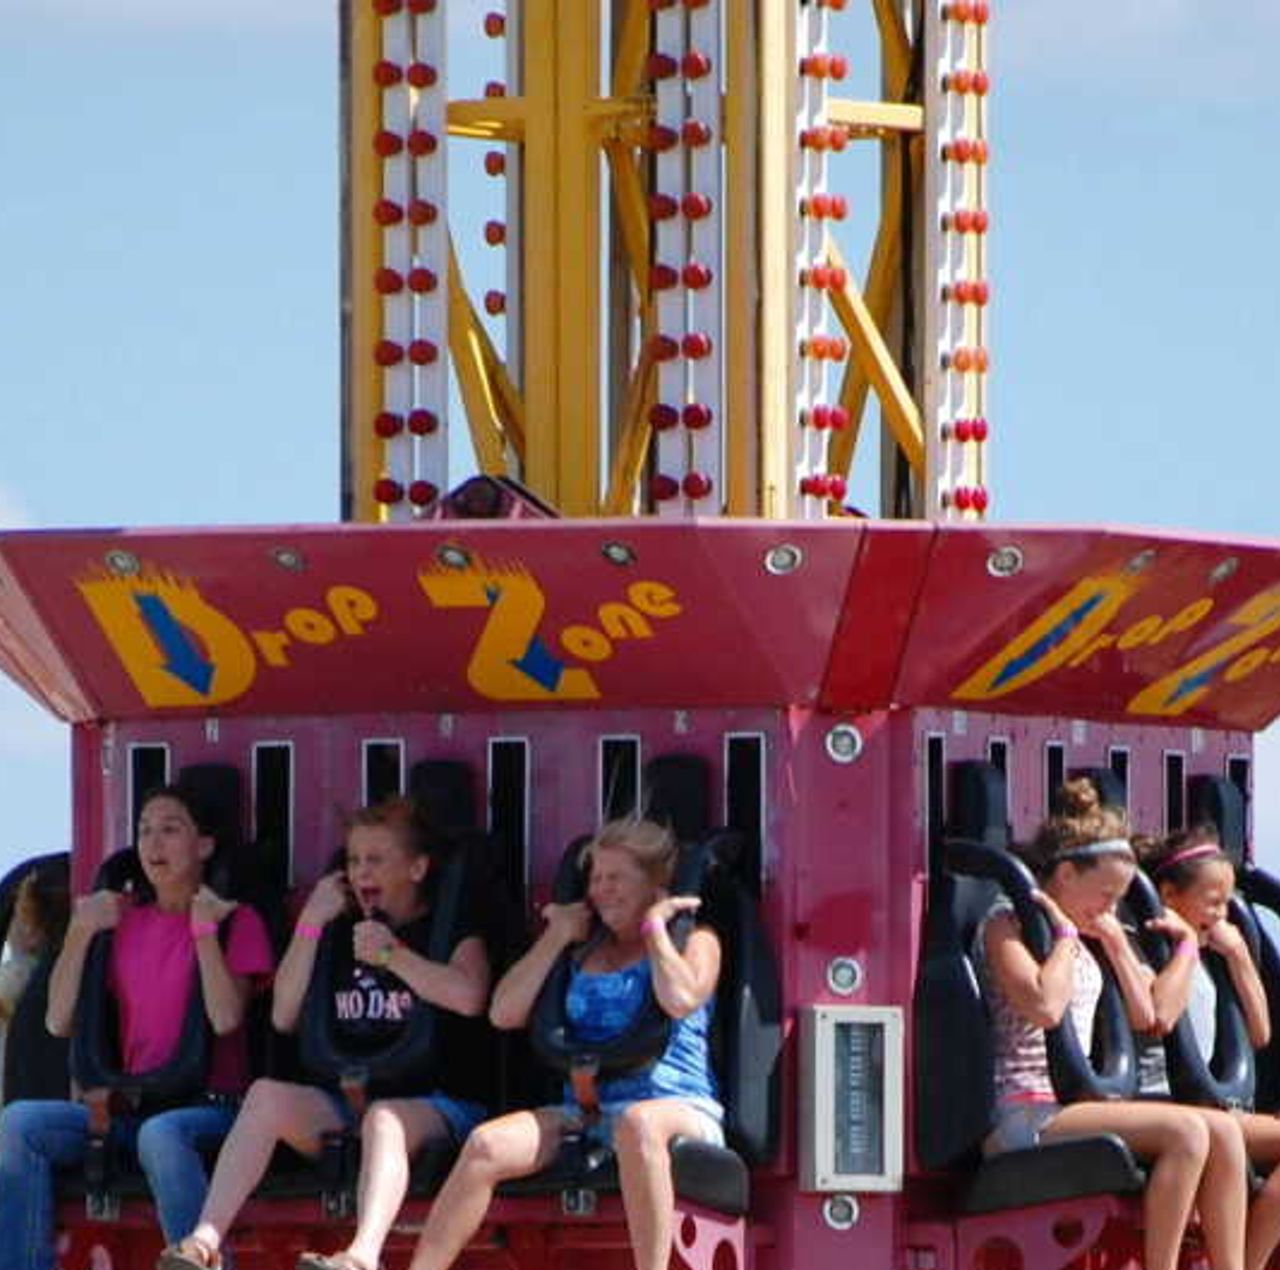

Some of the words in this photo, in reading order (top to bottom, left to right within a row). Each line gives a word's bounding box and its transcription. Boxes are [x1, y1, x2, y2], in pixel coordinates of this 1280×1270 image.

[76, 572, 378, 707] Drop
[418, 557, 682, 701] Zone
[951, 576, 1215, 699] Drop
